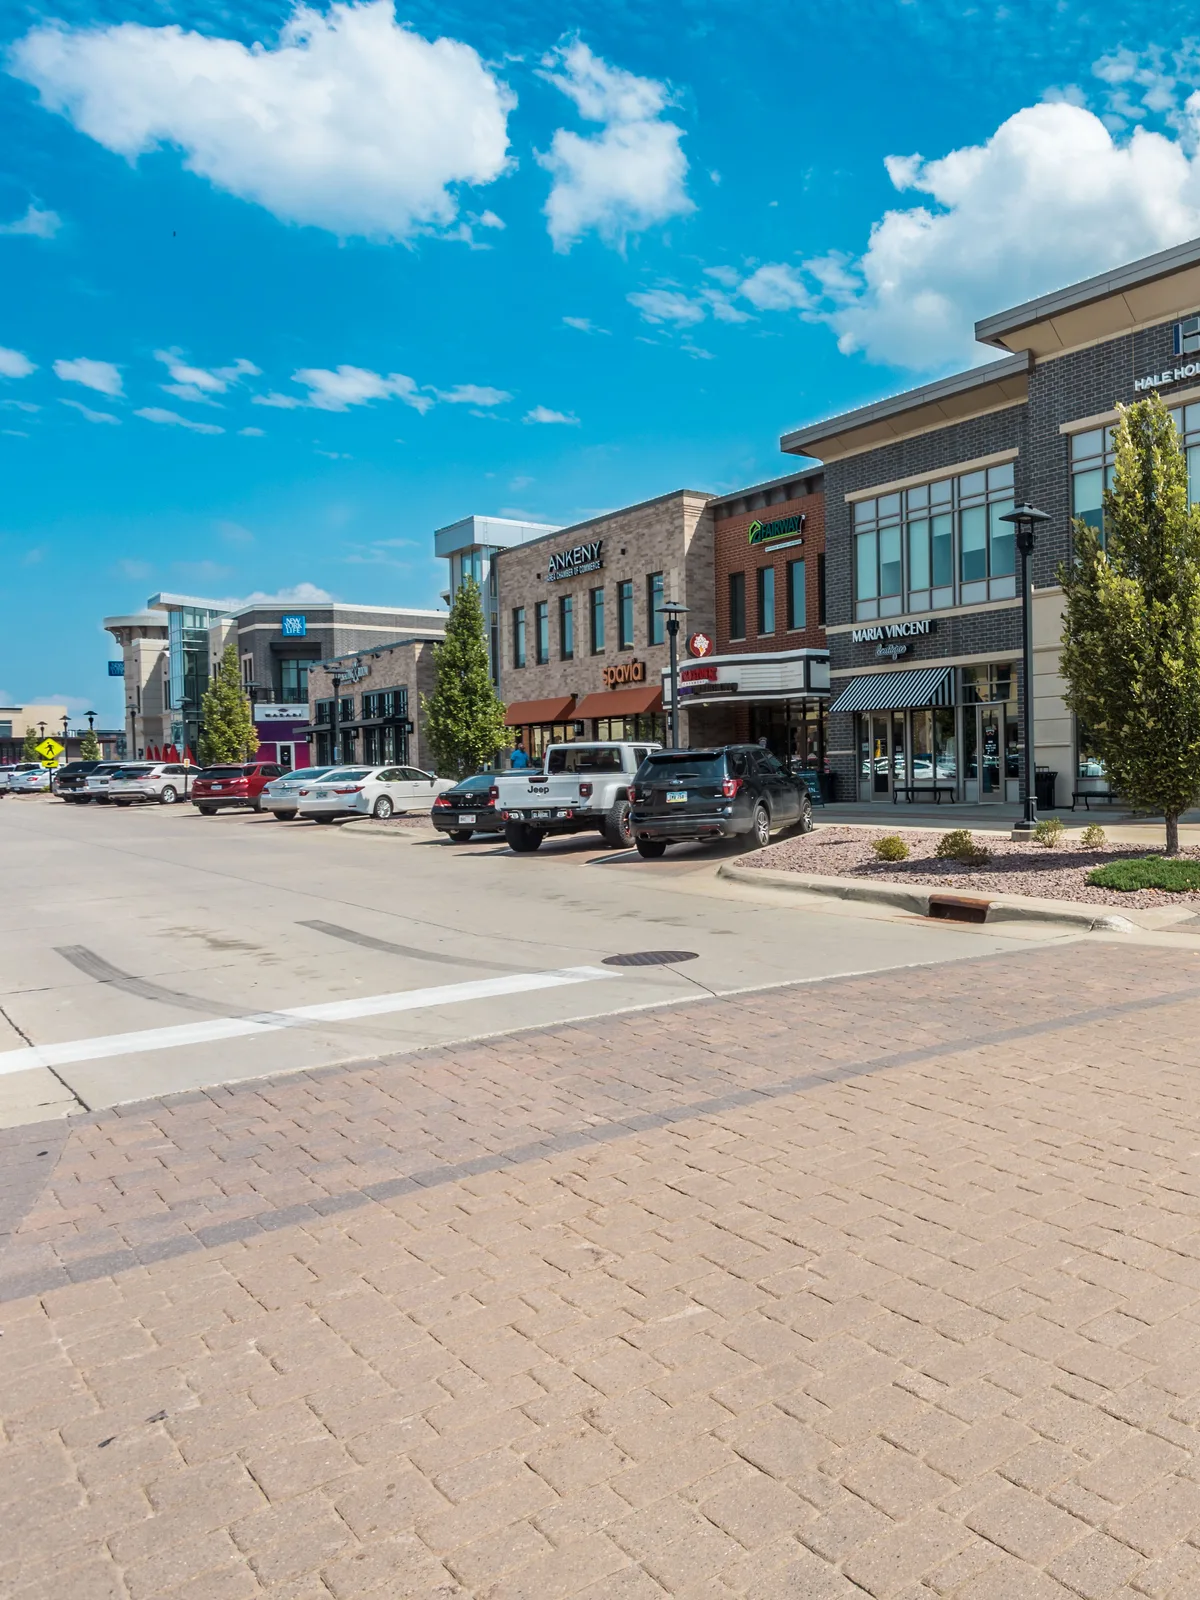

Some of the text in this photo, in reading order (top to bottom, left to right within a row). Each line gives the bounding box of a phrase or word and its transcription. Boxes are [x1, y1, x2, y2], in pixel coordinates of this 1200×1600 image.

[1135, 370, 1174, 391] HALE
[761, 515, 800, 539] FAIRWAY
[548, 540, 600, 572] ANKENY
[852, 619, 932, 643] MARIA VINCENT
[602, 662, 645, 690] spavia
[527, 785, 550, 794] Jeep
